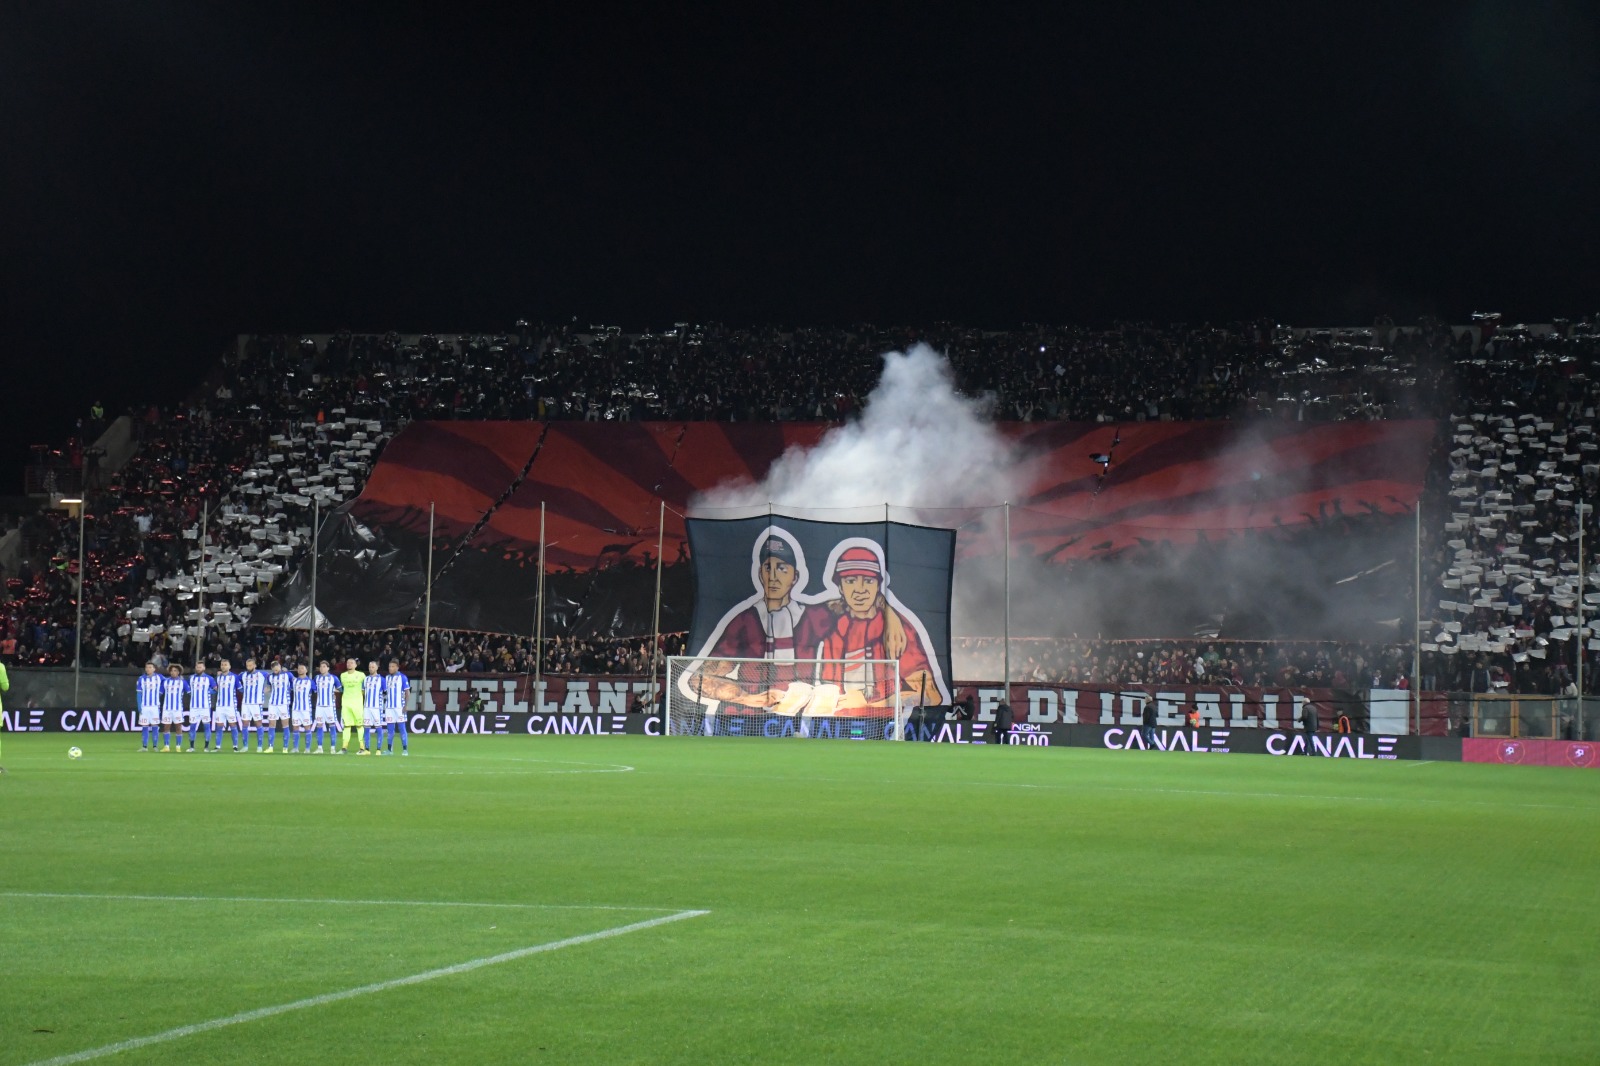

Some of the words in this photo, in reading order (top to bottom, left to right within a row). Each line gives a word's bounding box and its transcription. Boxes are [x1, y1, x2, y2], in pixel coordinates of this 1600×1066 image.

[1027, 690, 1079, 724] DI
[60, 710, 144, 732] CANAL
[410, 713, 511, 735] CANALE
[527, 715, 628, 736] CANALE
[1103, 728, 1231, 753] CANALE
[1266, 733, 1398, 760] CANALE
